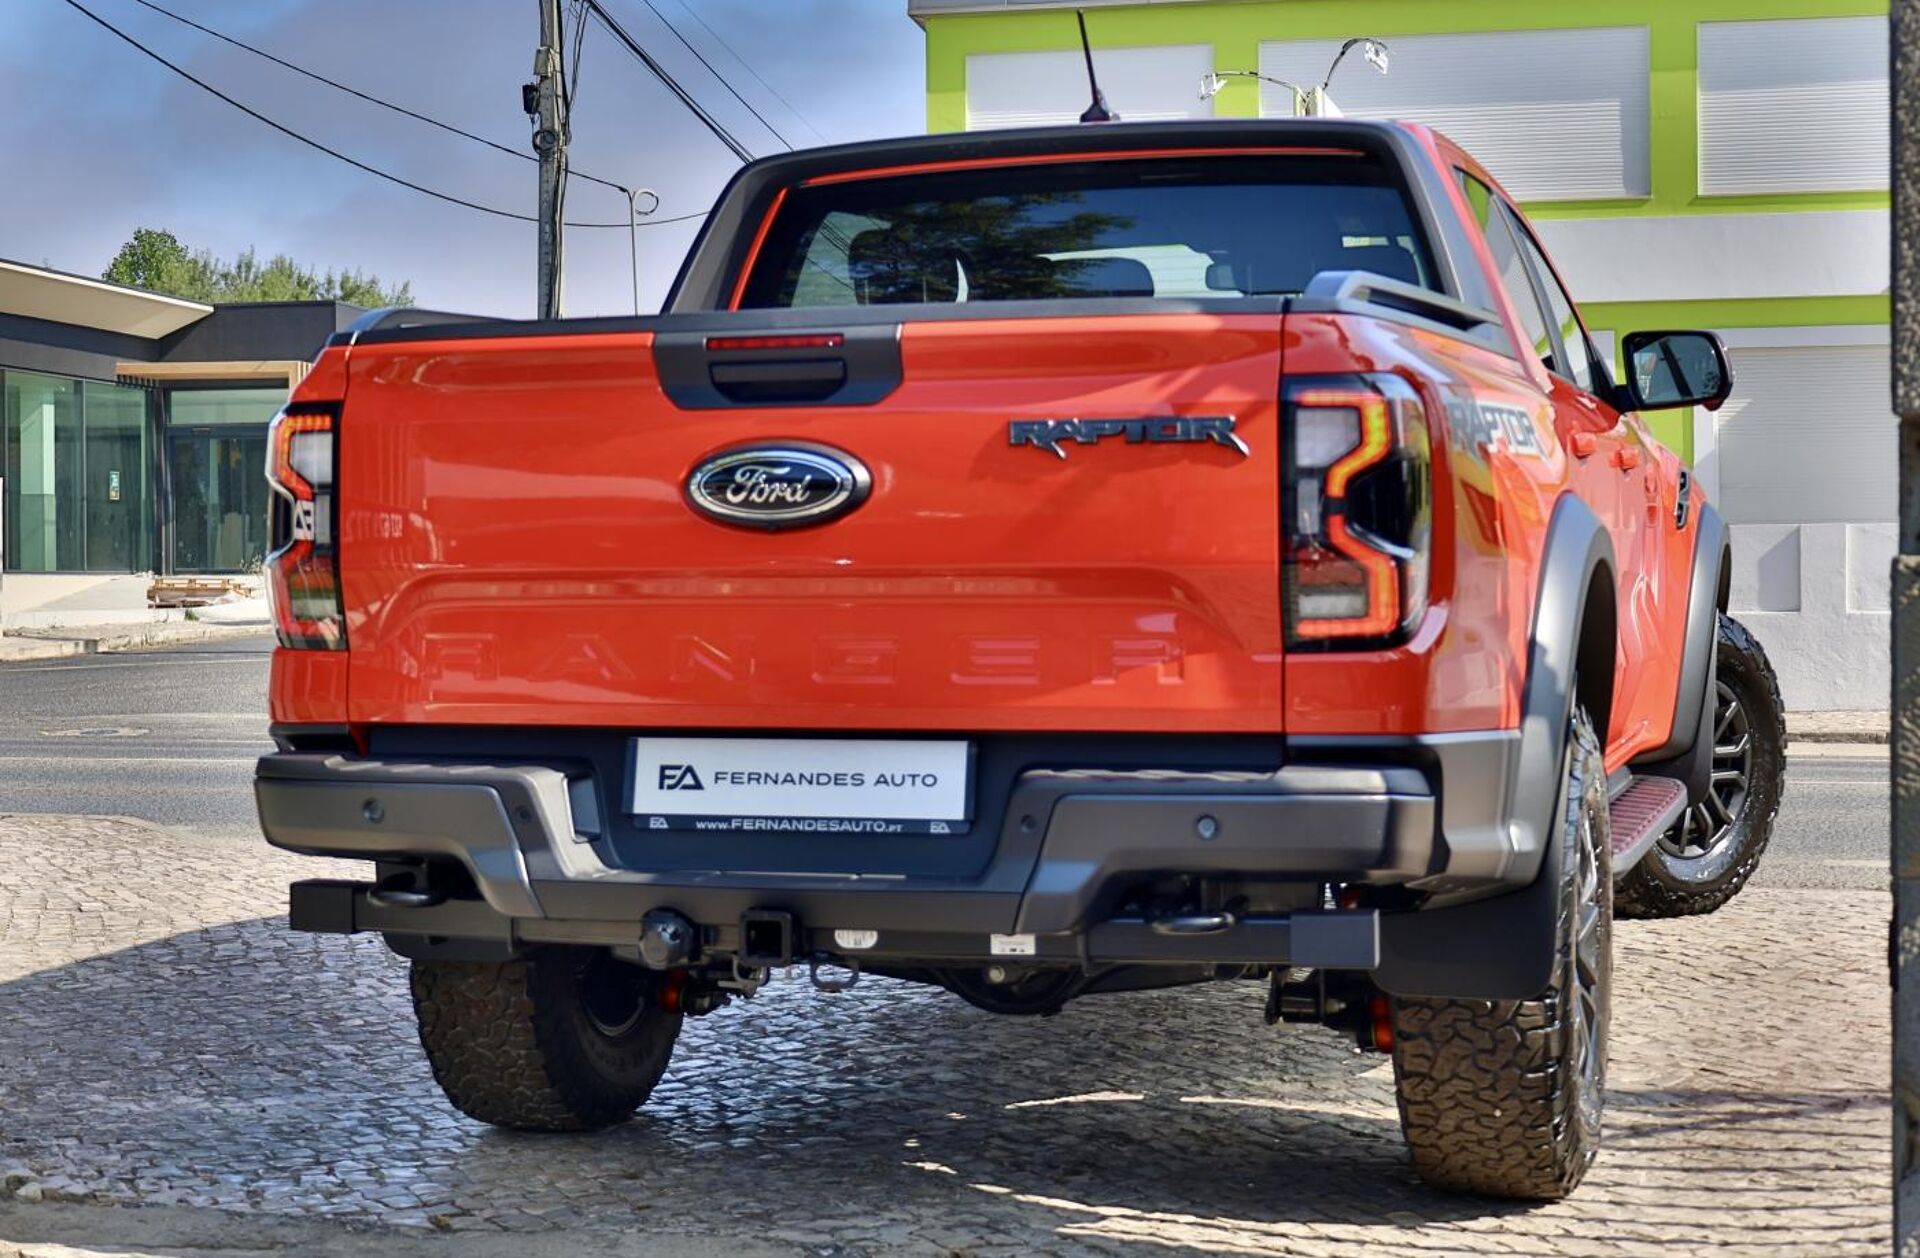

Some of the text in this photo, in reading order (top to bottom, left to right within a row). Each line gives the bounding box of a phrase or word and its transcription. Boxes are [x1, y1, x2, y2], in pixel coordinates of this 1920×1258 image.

[1008, 416, 1250, 460] RAPTOR
[1448, 400, 1550, 466] RAPTOR
[725, 464, 810, 504] Ford
[421, 631, 1186, 686] RANGER
[714, 771, 938, 788] FERNANDES AUTO
